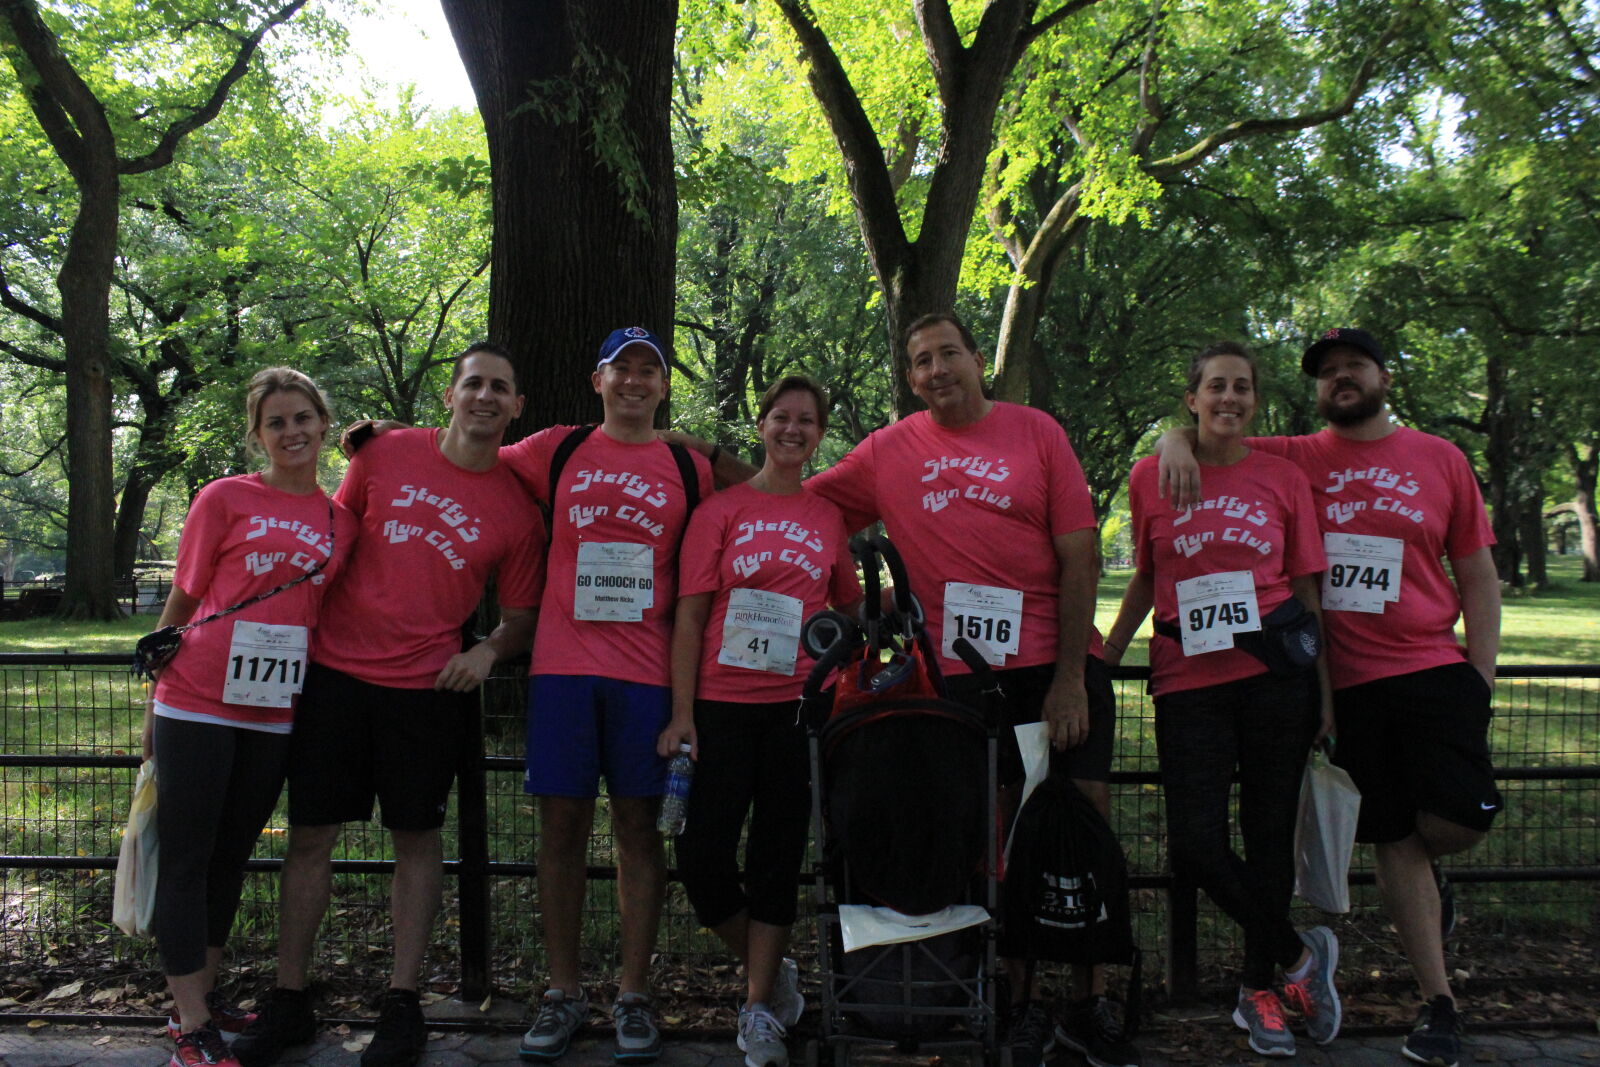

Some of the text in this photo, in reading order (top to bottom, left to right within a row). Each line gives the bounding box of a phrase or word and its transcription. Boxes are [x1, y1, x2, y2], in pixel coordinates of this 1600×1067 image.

[922, 485, 1012, 513] Run Club
[1326, 497, 1425, 525] Run Club
[568, 504, 665, 538] Run Club
[383, 519, 466, 571] Run Club
[1173, 527, 1272, 558] Run Club
[245, 550, 287, 577] Run
[732, 548, 823, 582] Run Club
[1331, 564, 1390, 591] 9744
[577, 575, 652, 590] GO CHOOCH GO
[954, 614, 1012, 643] 1516
[1188, 601, 1249, 632] 9745
[748, 637, 769, 655] 41
[232, 655, 301, 684] 11711
